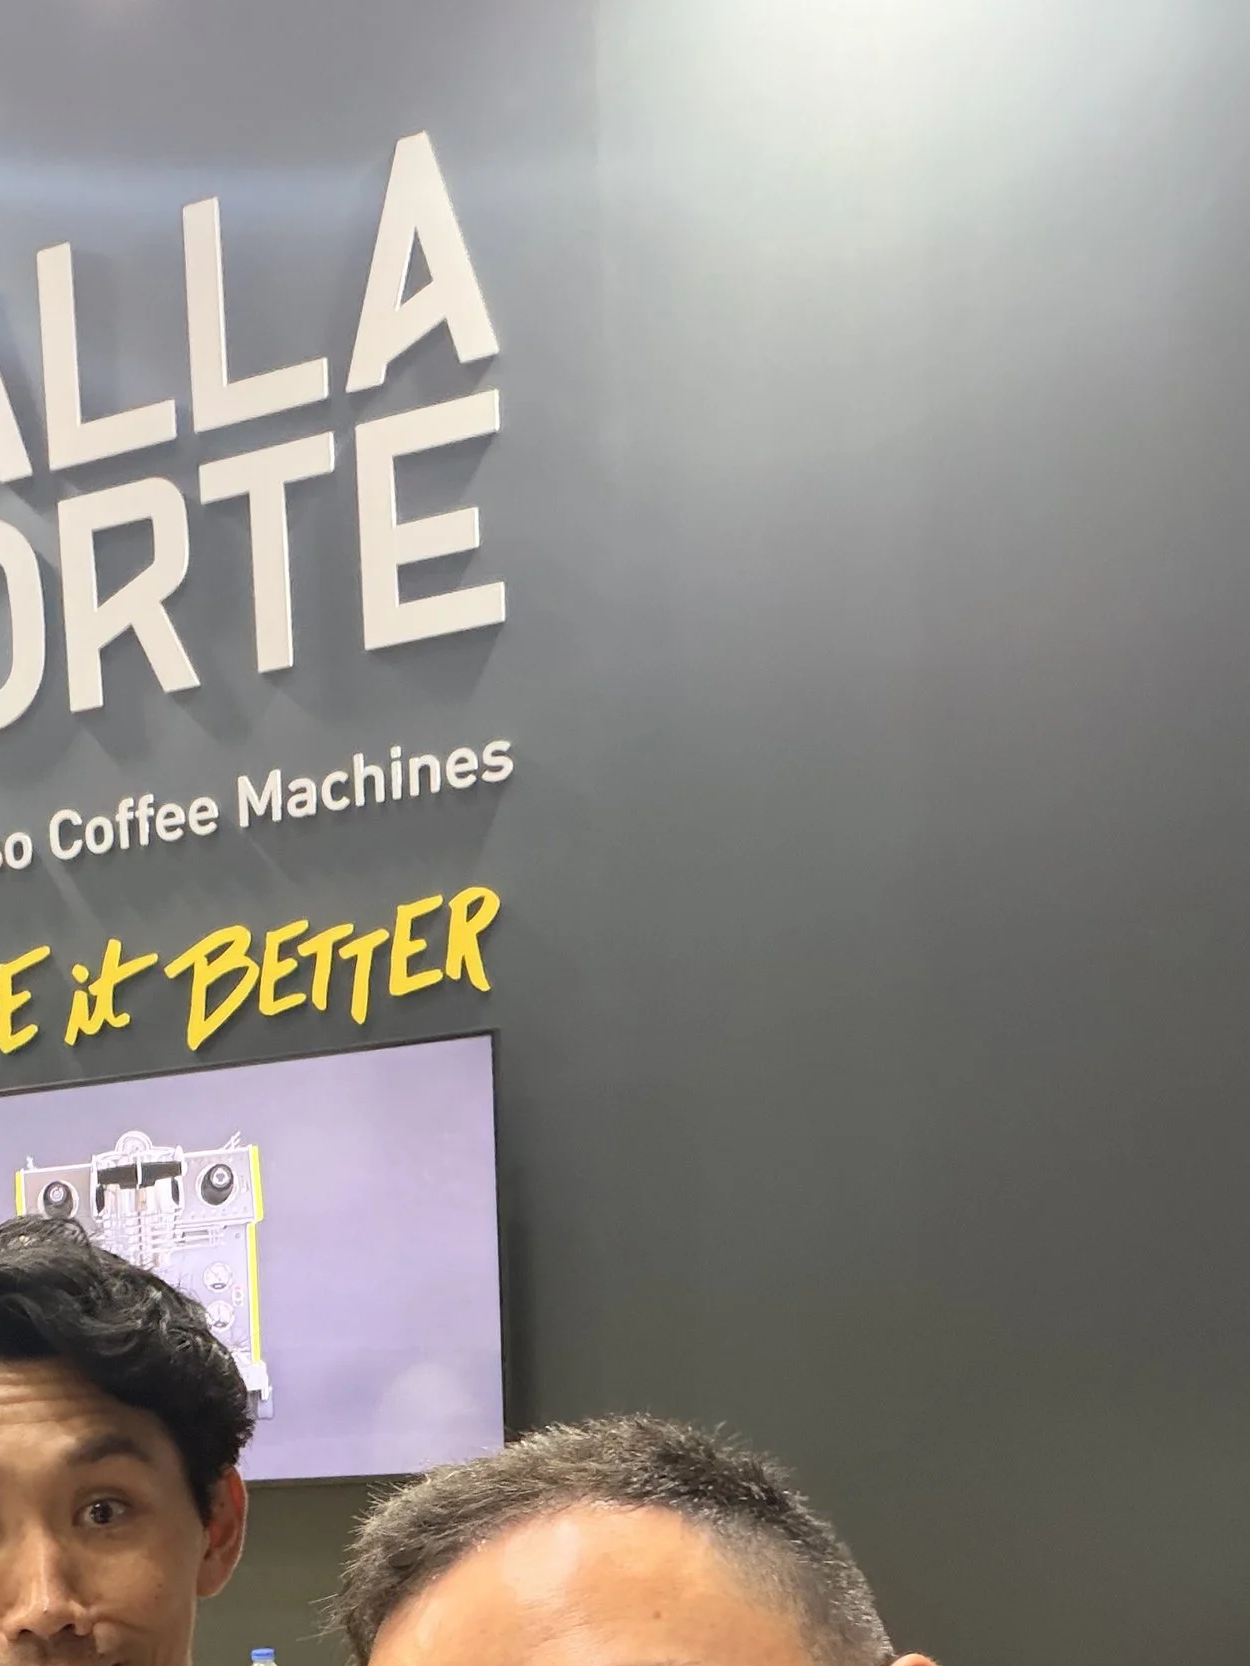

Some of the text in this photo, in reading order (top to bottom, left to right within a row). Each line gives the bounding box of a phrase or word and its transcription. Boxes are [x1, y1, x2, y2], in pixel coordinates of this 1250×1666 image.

[49, 793, 219, 860] Coffee
[237, 740, 514, 828] Machines
[64, 938, 158, 1046] it
[166, 885, 502, 1052] BETTER
